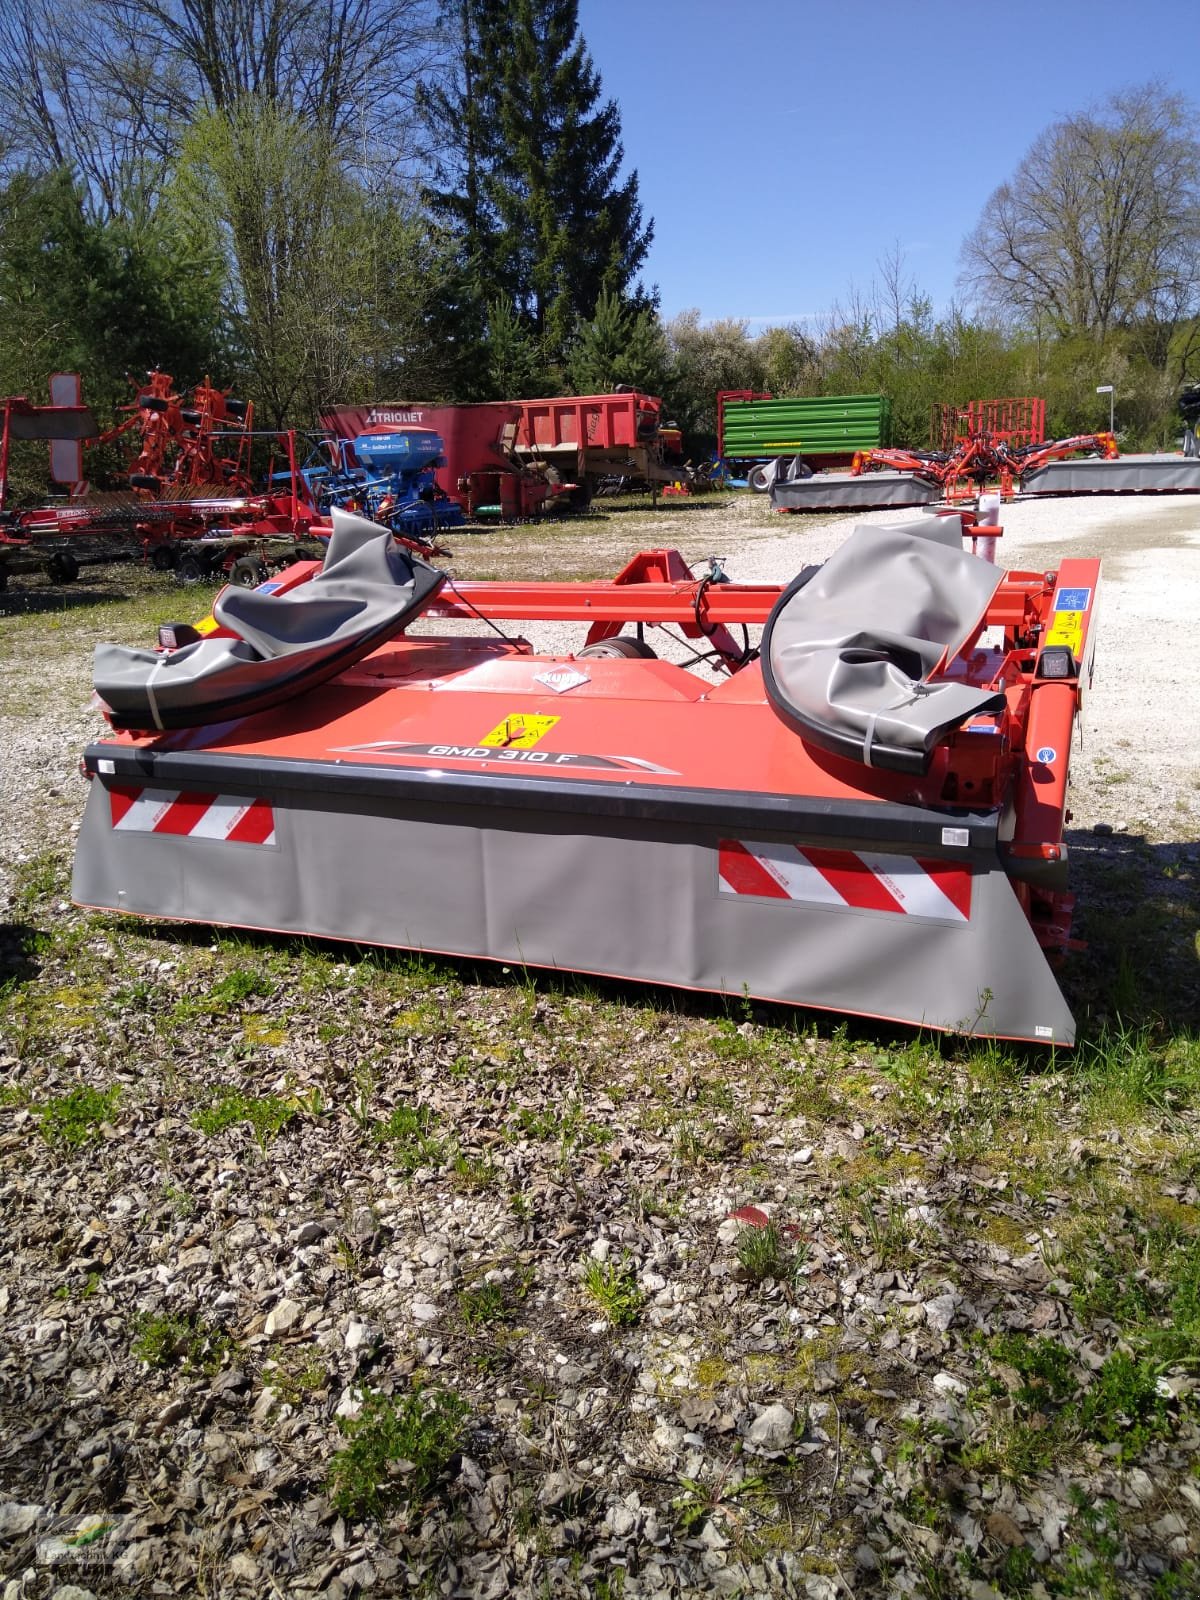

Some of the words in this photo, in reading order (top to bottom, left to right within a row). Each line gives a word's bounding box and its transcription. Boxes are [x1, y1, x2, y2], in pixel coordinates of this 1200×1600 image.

[376, 411, 423, 423] TRIOLIET
[427, 745, 490, 757] GMD
[498, 750, 549, 762] 310
[555, 754, 578, 764] F
